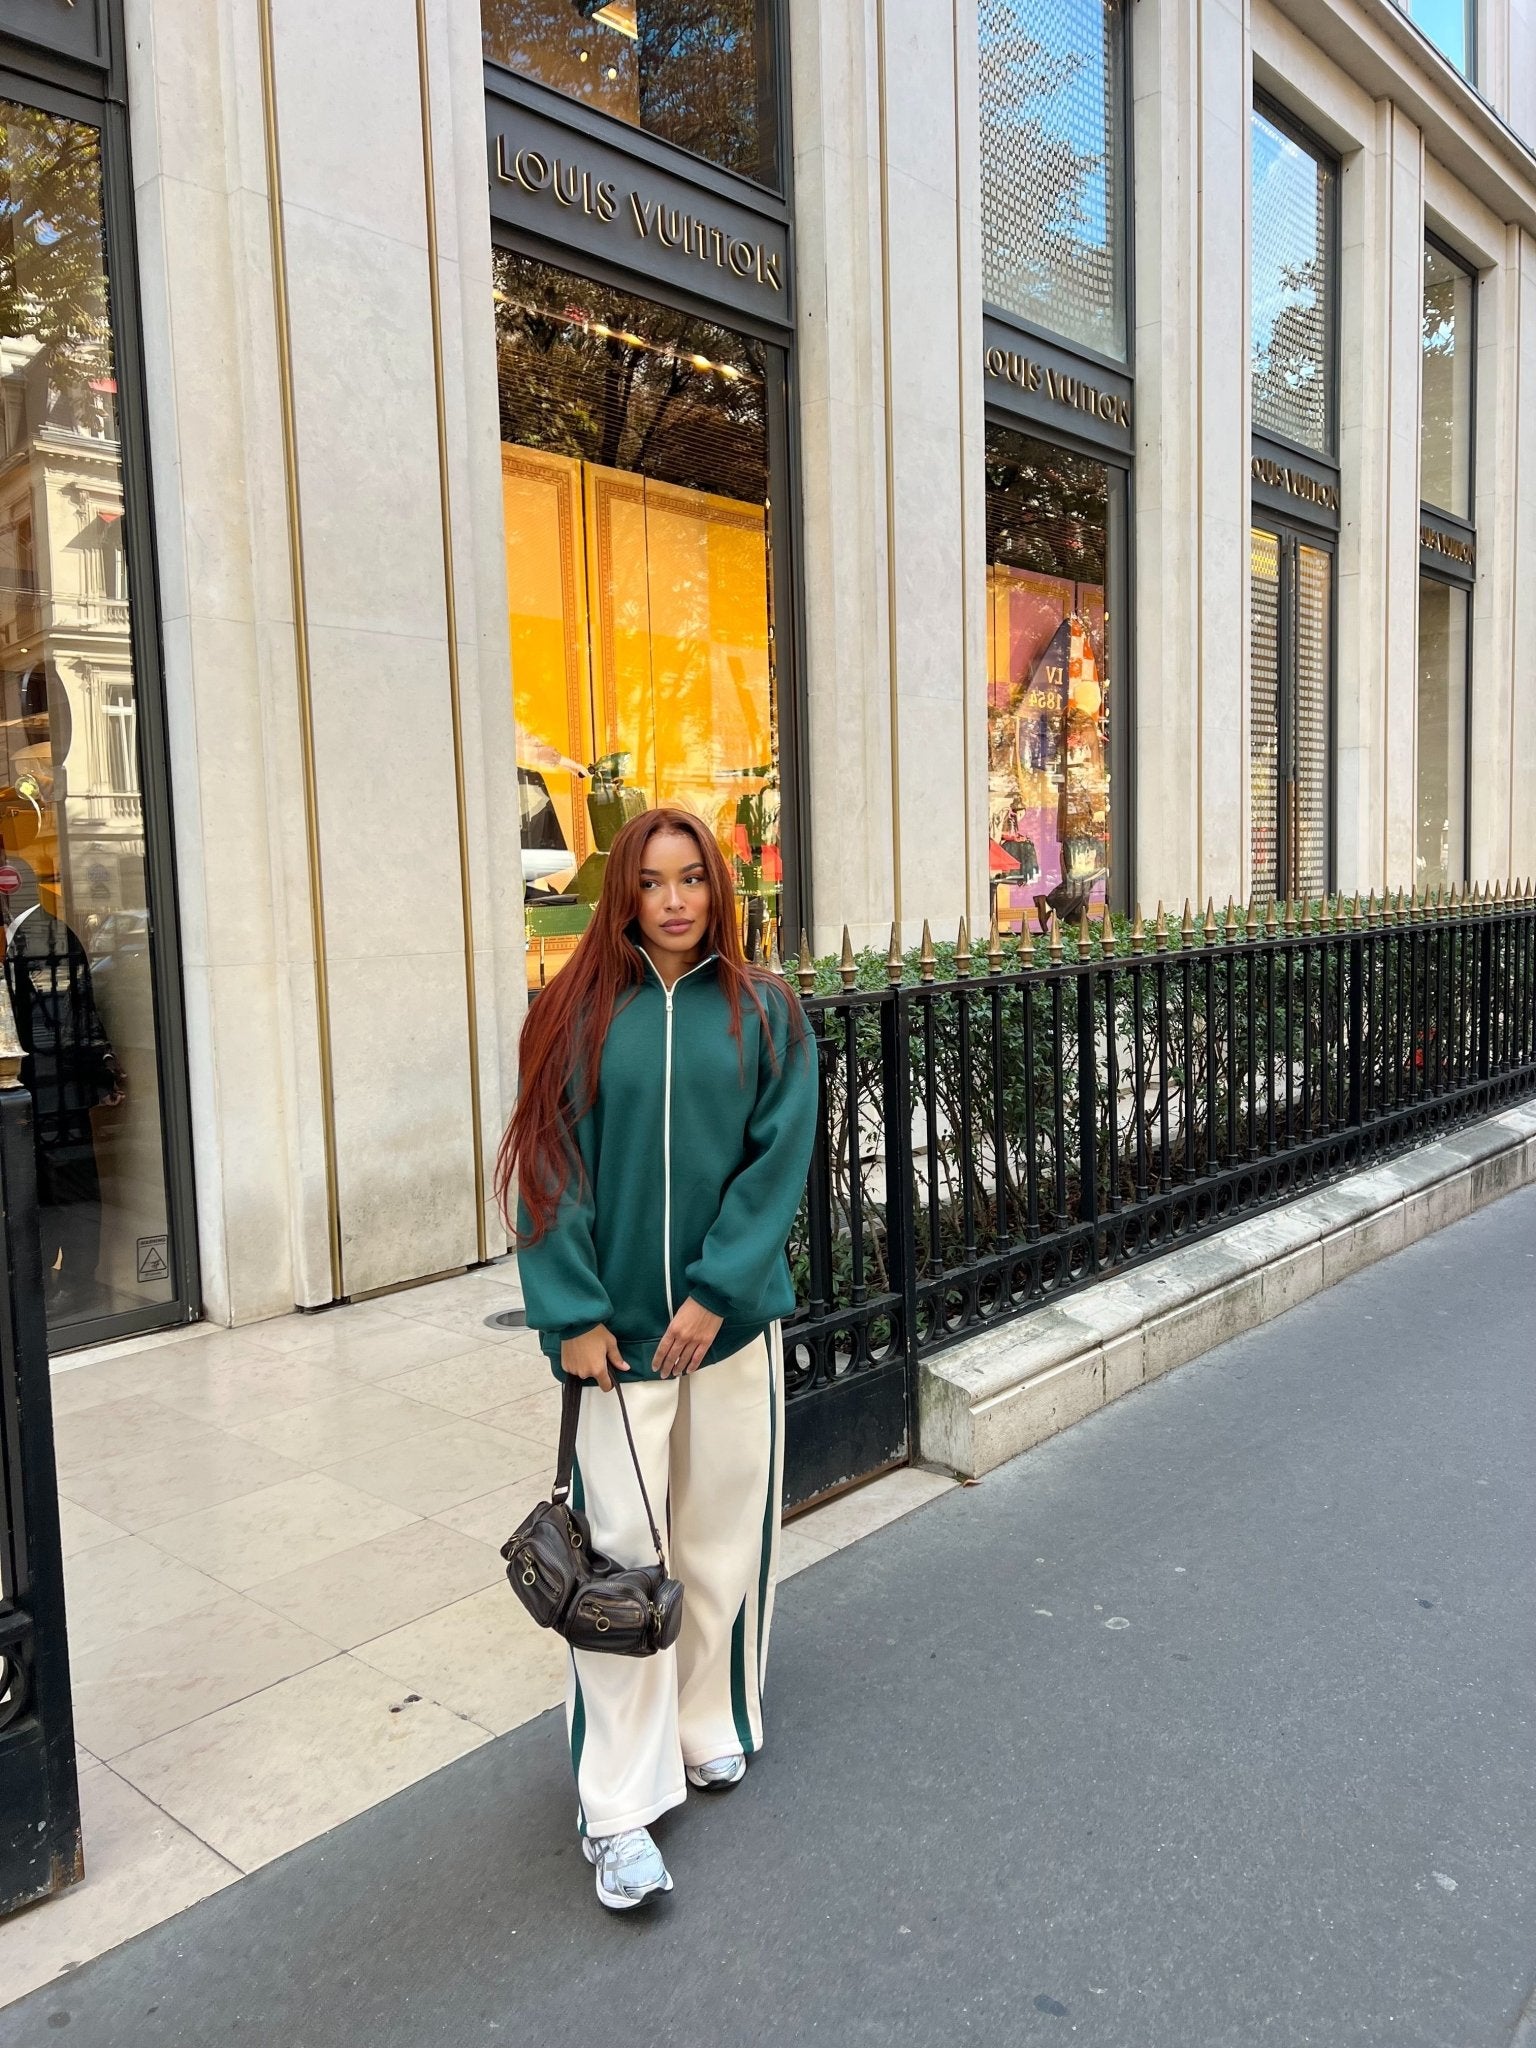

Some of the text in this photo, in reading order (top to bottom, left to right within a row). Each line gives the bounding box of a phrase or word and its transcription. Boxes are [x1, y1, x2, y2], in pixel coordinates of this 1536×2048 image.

[496, 133, 783, 291] LOUIS VUITTON
[985, 346, 1130, 428] OUIS VUITTON
[1251, 455, 1284, 487] OUIS
